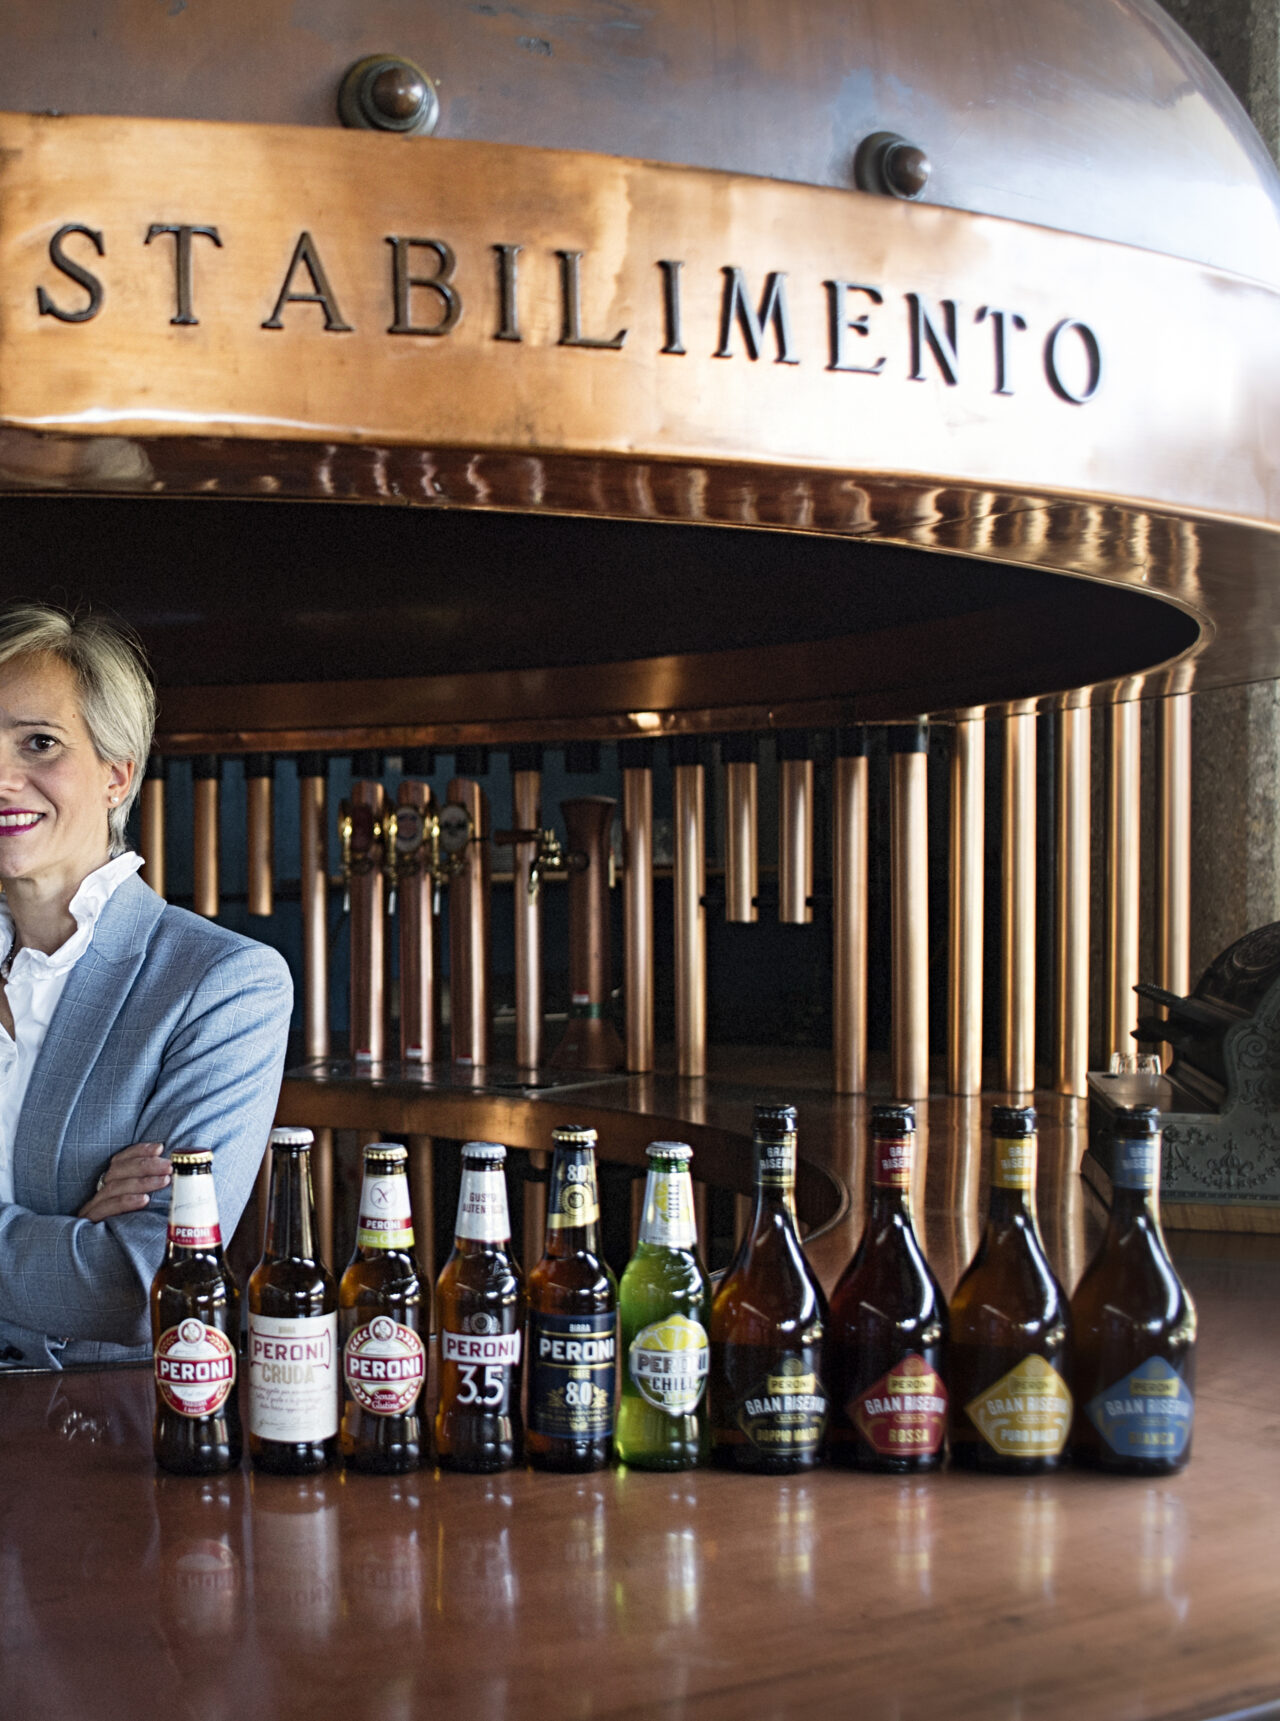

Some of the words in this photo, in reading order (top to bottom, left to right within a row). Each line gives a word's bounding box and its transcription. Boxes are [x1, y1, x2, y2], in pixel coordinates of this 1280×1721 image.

[37, 221, 1104, 405] STABILIMENTO
[470, 1192, 496, 1202] GUSO
[175, 1227, 211, 1238] PERONI
[366, 1220, 401, 1229] PERONI
[253, 1341, 325, 1361] PERONI
[447, 1338, 515, 1357] PERONI
[539, 1337, 615, 1361] PERONI
[160, 1358, 230, 1381] PERONI
[261, 1362, 316, 1384] CRUDA
[349, 1357, 421, 1379] PERONI
[456, 1365, 504, 1405] 3.5
[373, 1391, 397, 1401] Senza
